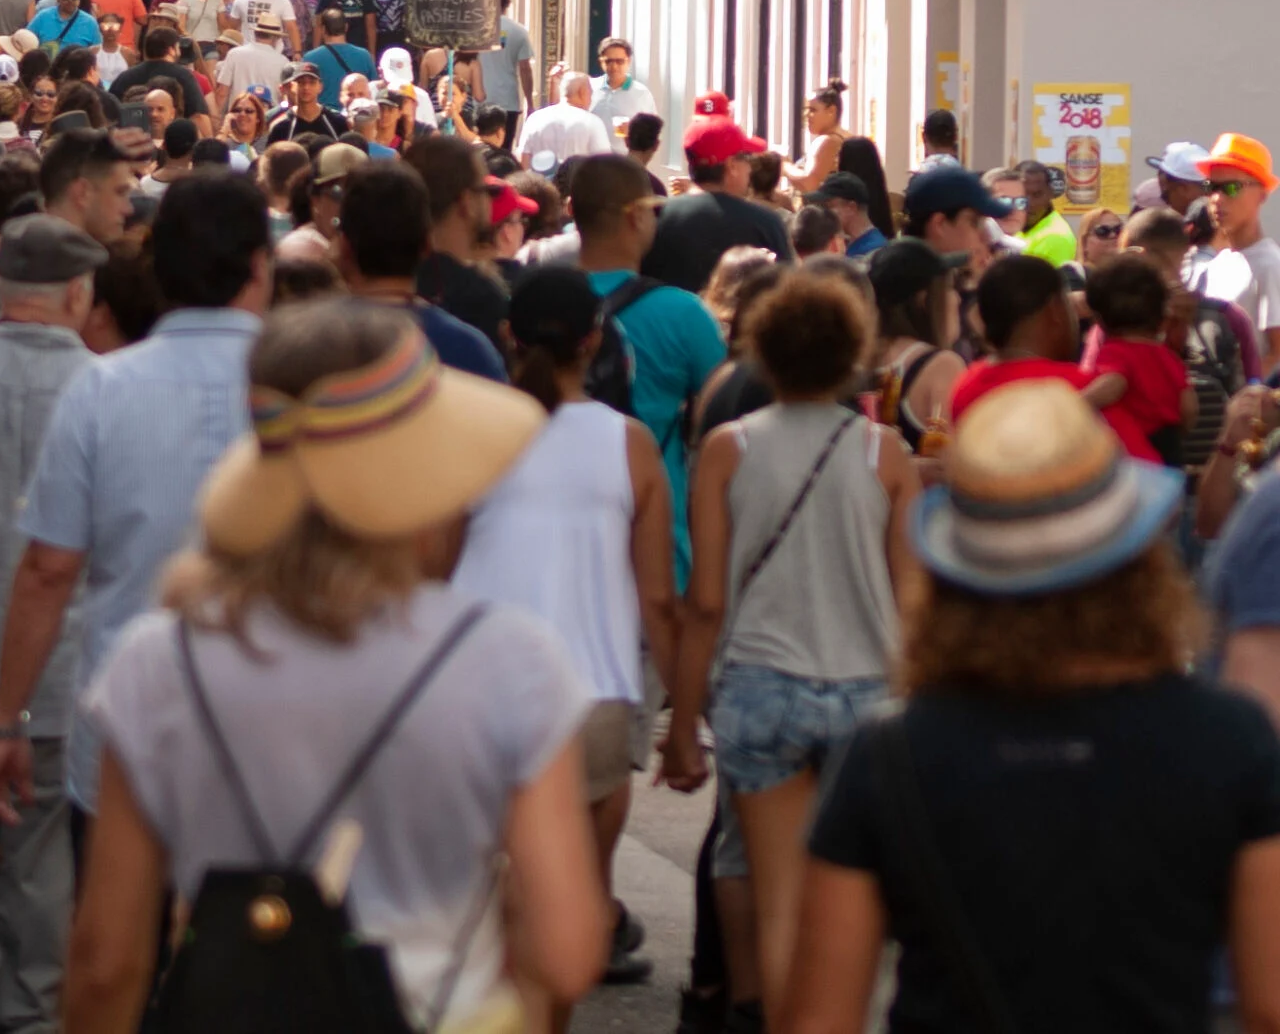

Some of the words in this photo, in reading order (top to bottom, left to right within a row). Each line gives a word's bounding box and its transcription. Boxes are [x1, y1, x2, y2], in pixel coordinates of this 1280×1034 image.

[421, 7, 485, 24] PASTELES
[1060, 93, 1103, 104] SANSE
[1059, 103, 1102, 129] 2018
